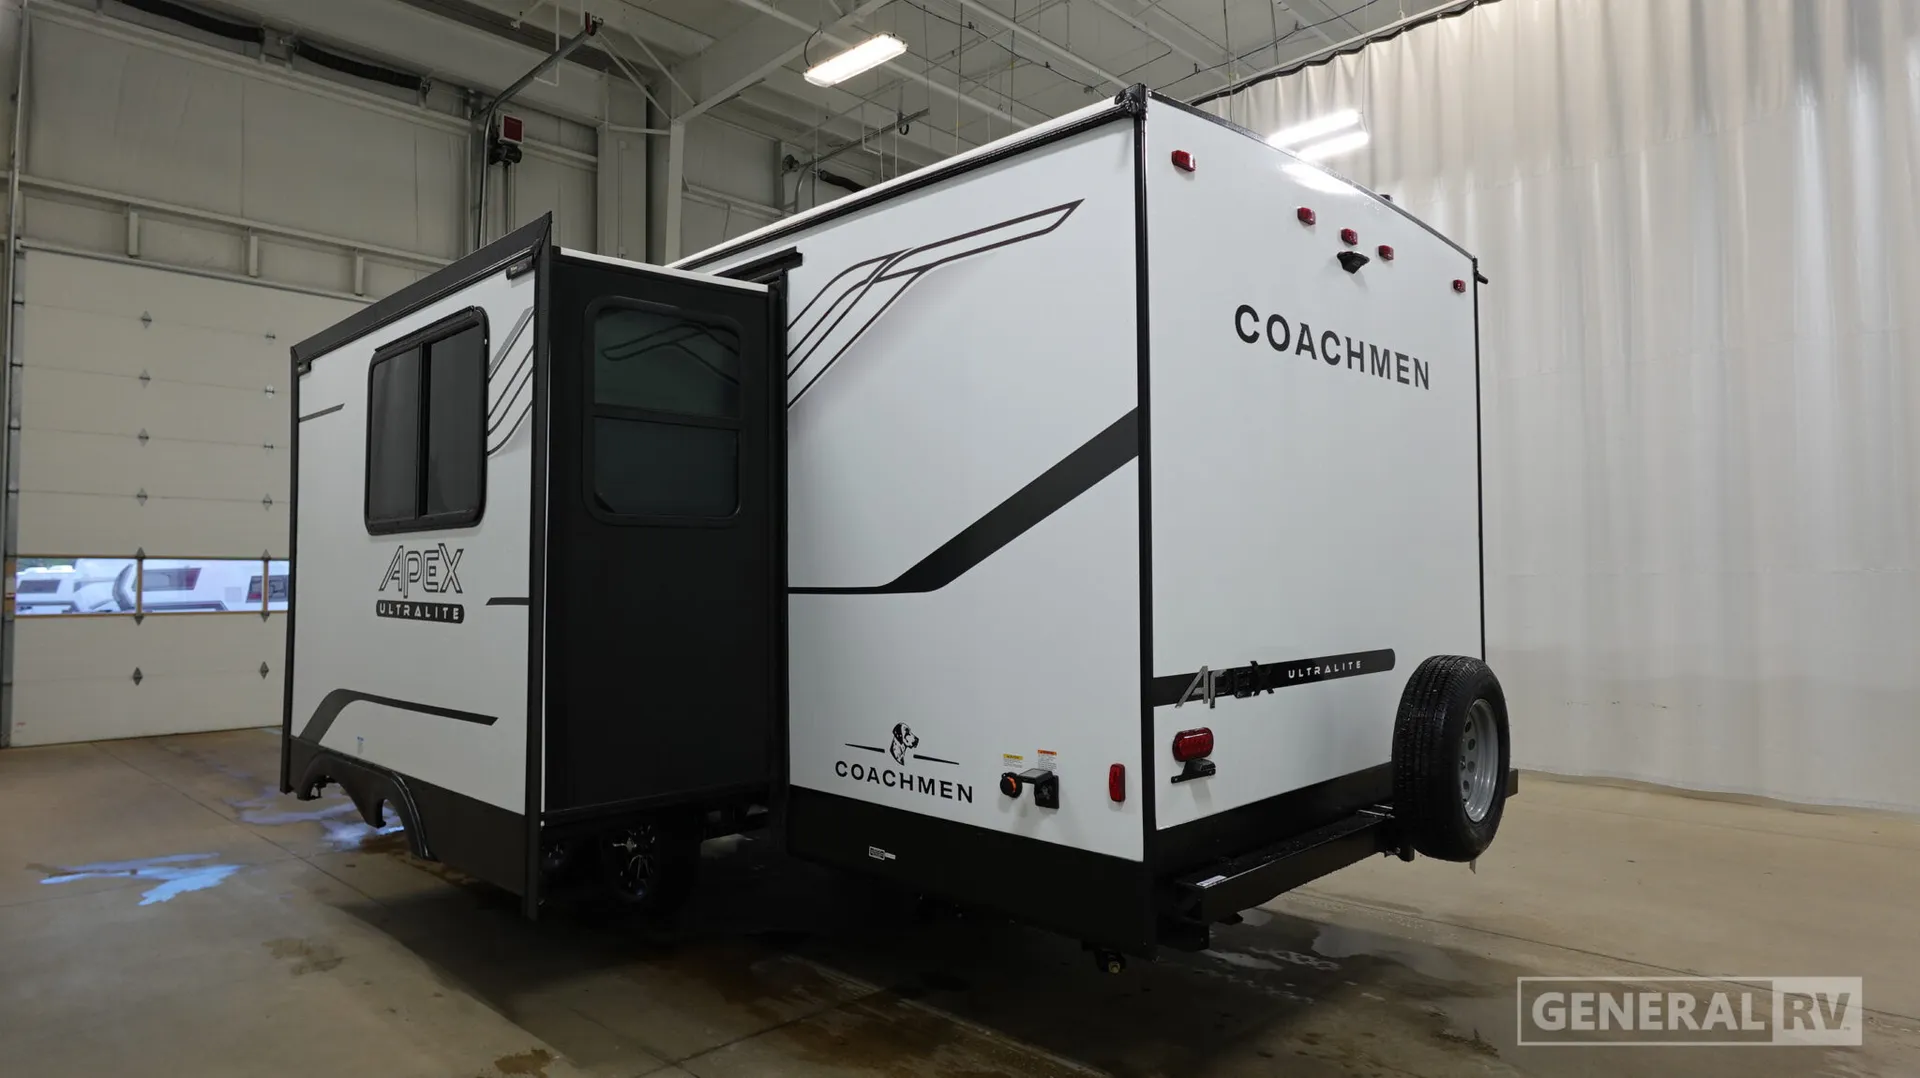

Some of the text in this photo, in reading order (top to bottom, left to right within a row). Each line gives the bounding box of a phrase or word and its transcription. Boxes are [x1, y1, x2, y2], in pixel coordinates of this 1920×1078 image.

[1234, 304, 1430, 391] COACHMEN
[378, 542, 464, 599] APEX
[379, 602, 460, 620] ULTRALITE
[1174, 660, 1362, 709] APEX ULTRALITE
[835, 760, 973, 804] COACHMEN
